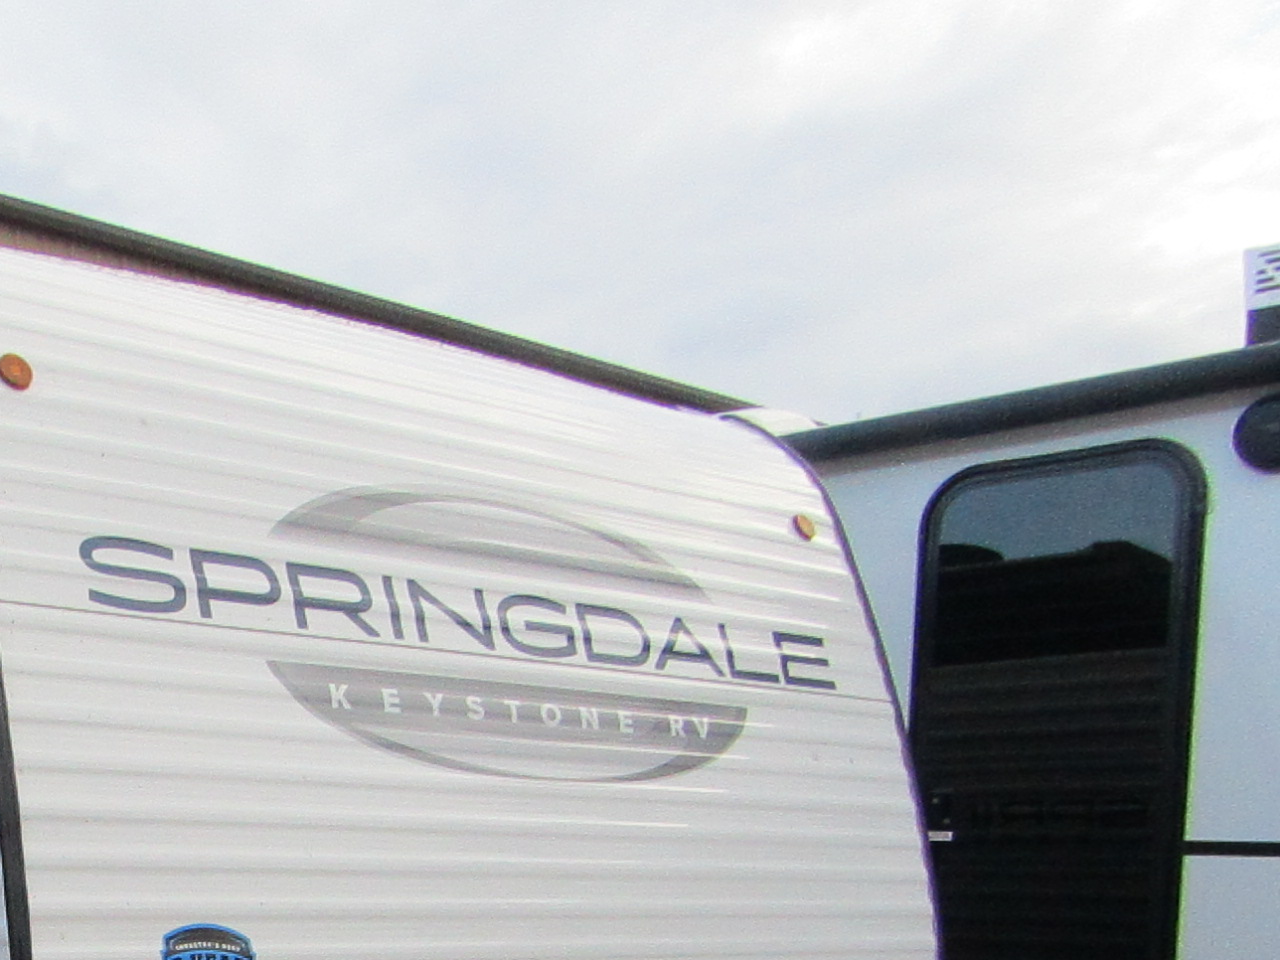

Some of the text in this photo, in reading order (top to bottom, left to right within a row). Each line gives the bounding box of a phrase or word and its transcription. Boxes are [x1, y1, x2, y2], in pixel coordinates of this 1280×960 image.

[78, 535, 837, 691] SPRINGDALE
[328, 682, 710, 740] KEYSTONE RV
